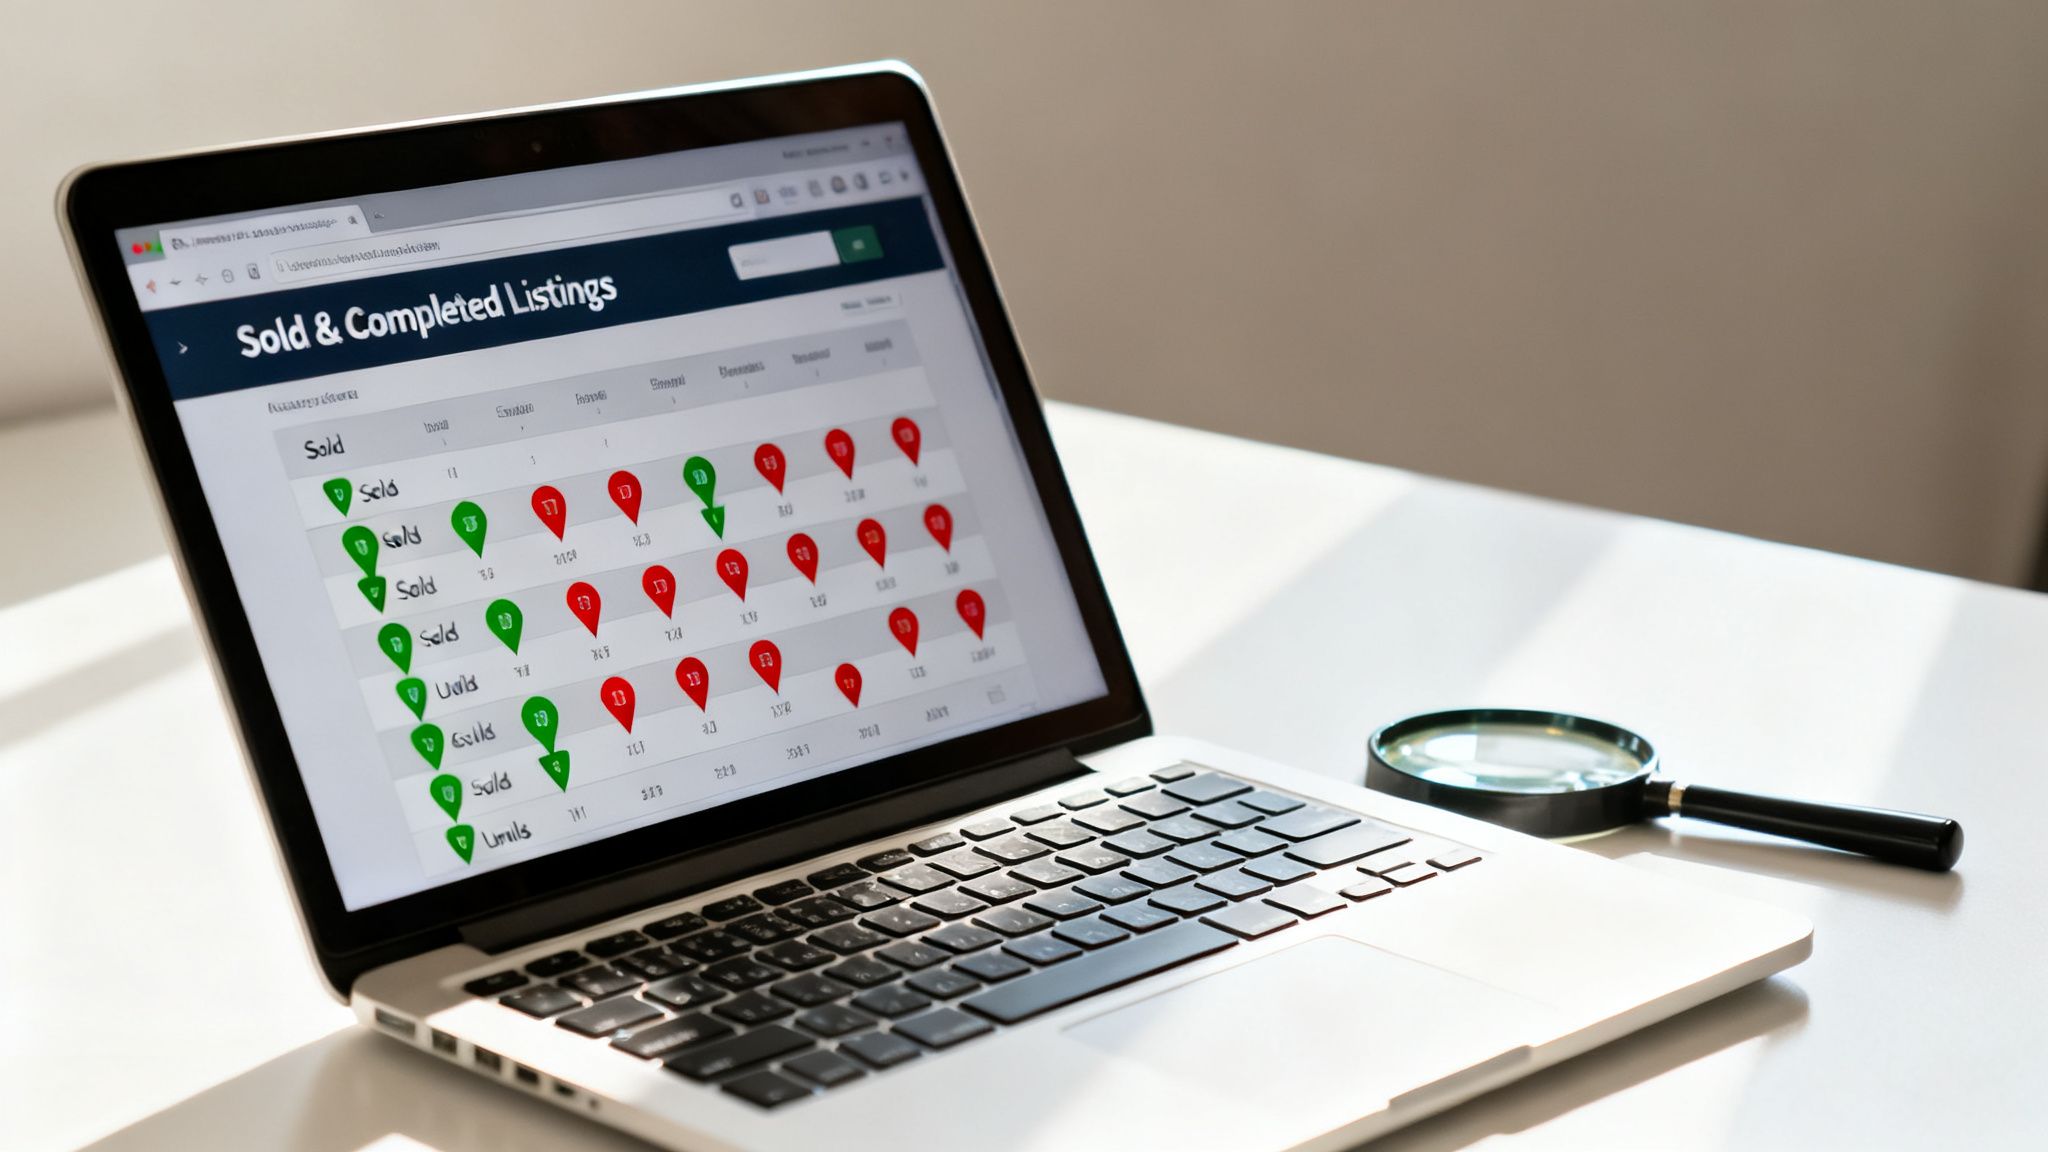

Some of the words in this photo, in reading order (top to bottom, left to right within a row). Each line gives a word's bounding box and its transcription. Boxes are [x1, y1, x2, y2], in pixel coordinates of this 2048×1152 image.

[237, 314, 311, 358] Sold
[315, 311, 342, 345] &
[345, 284, 505, 339] Completed
[504, 274, 618, 312] Listings
[304, 434, 345, 459] Sold
[359, 479, 399, 502] Sold
[382, 525, 422, 549] Sold
[396, 576, 437, 600] Sold
[420, 621, 460, 647] Sold
